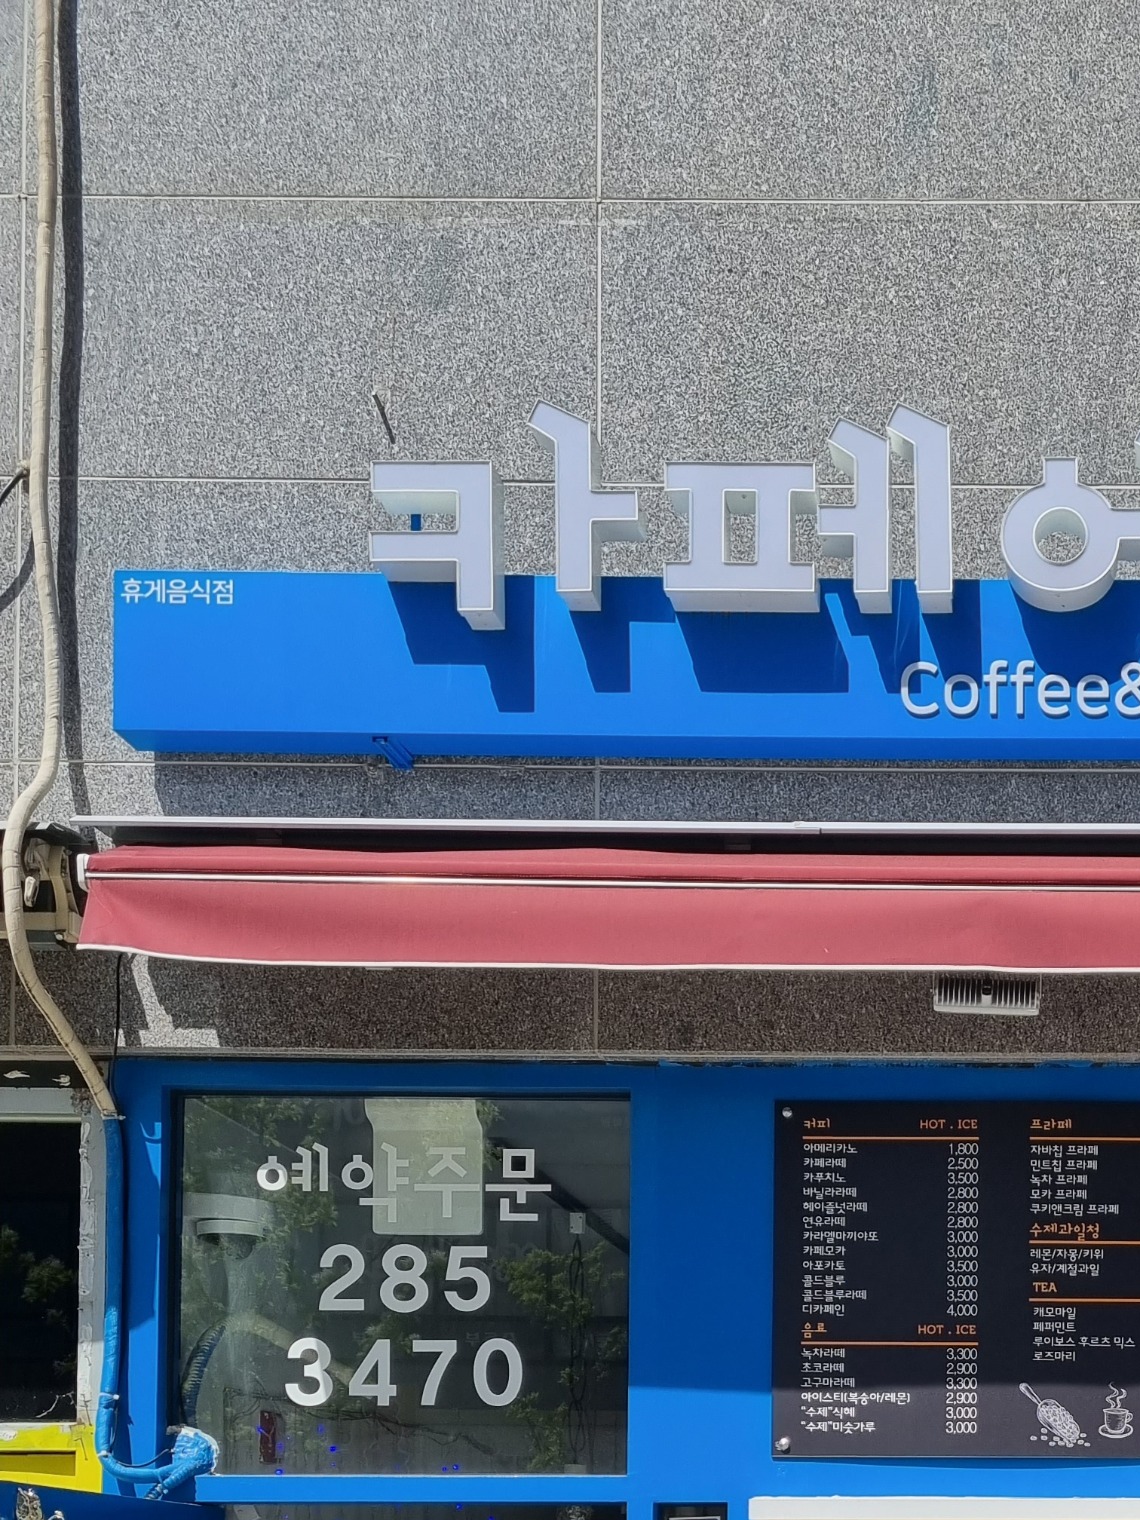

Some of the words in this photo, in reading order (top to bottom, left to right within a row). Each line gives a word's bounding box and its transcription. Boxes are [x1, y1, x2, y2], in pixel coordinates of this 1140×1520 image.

[119, 576, 235, 607] 휴게음식점
[804, 1118, 830, 1128] 커피
[920, 1120, 945, 1129] HOT
[958, 1120, 977, 1129] ICE
[1030, 1119, 1071, 1130] 프라페
[804, 1144, 857, 1153] 아메리카노
[950, 1143, 978, 1154] 1,800
[1031, 1145, 1062, 1157] 자바칩
[1066, 1146, 1098, 1155] 프라페
[804, 1158, 846, 1167] 카페라떼
[948, 1158, 978, 1169] 2,500
[1031, 1160, 1061, 1172] 민트칩
[1065, 1160, 1097, 1170] 프라페
[255, 1141, 553, 1224] 예약주문
[804, 1173, 846, 1182] 카푸치노
[948, 1172, 978, 1184] 3,500
[1030, 1175, 1052, 1186] 녹차
[1055, 1175, 1087, 1184] 프라페
[803, 1187, 856, 1199] 바닐라라떼
[948, 1187, 978, 1198] 2,800
[1030, 1190, 1051, 1198] 모카
[1055, 1190, 1087, 1199] 프라페
[803, 1202, 867, 1214] 헤이즐넛라떼
[947, 1202, 978, 1213] 2,800
[1030, 1204, 1083, 1216] 쿠키앤크림
[1087, 1205, 1119, 1214] 프라페
[803, 1216, 845, 1228] 연유라떼
[948, 1216, 978, 1228] 2,800
[1030, 1223, 1099, 1241] 수제과일청
[803, 1246, 846, 1255] 카페모카
[947, 1246, 978, 1257] 3,000
[803, 1261, 845, 1270] 아포카토
[947, 1261, 978, 1272] 3,500
[317, 1243, 492, 1314] 285
[802, 1275, 845, 1287] 콜드블루
[947, 1275, 978, 1287] 3,000
[1033, 1282, 1057, 1292] TEA
[802, 1290, 866, 1302] 콜드블루라떼
[947, 1290, 978, 1301] 3,500
[803, 1304, 844, 1316] 디카페인
[947, 1304, 977, 1316] 4,000
[1034, 1307, 1076, 1319] 캐모마일
[801, 1348, 845, 1359] 녹차라떼
[947, 1348, 977, 1359] 3,300
[1033, 1352, 1075, 1361] 로즈마리
[284, 1336, 524, 1408] 3470
[801, 1363, 844, 1372] 초코라떼
[947, 1363, 977, 1374] 2,900
[801, 1378, 855, 1387] 고구마라떼
[946, 1378, 978, 1390] 3,300
